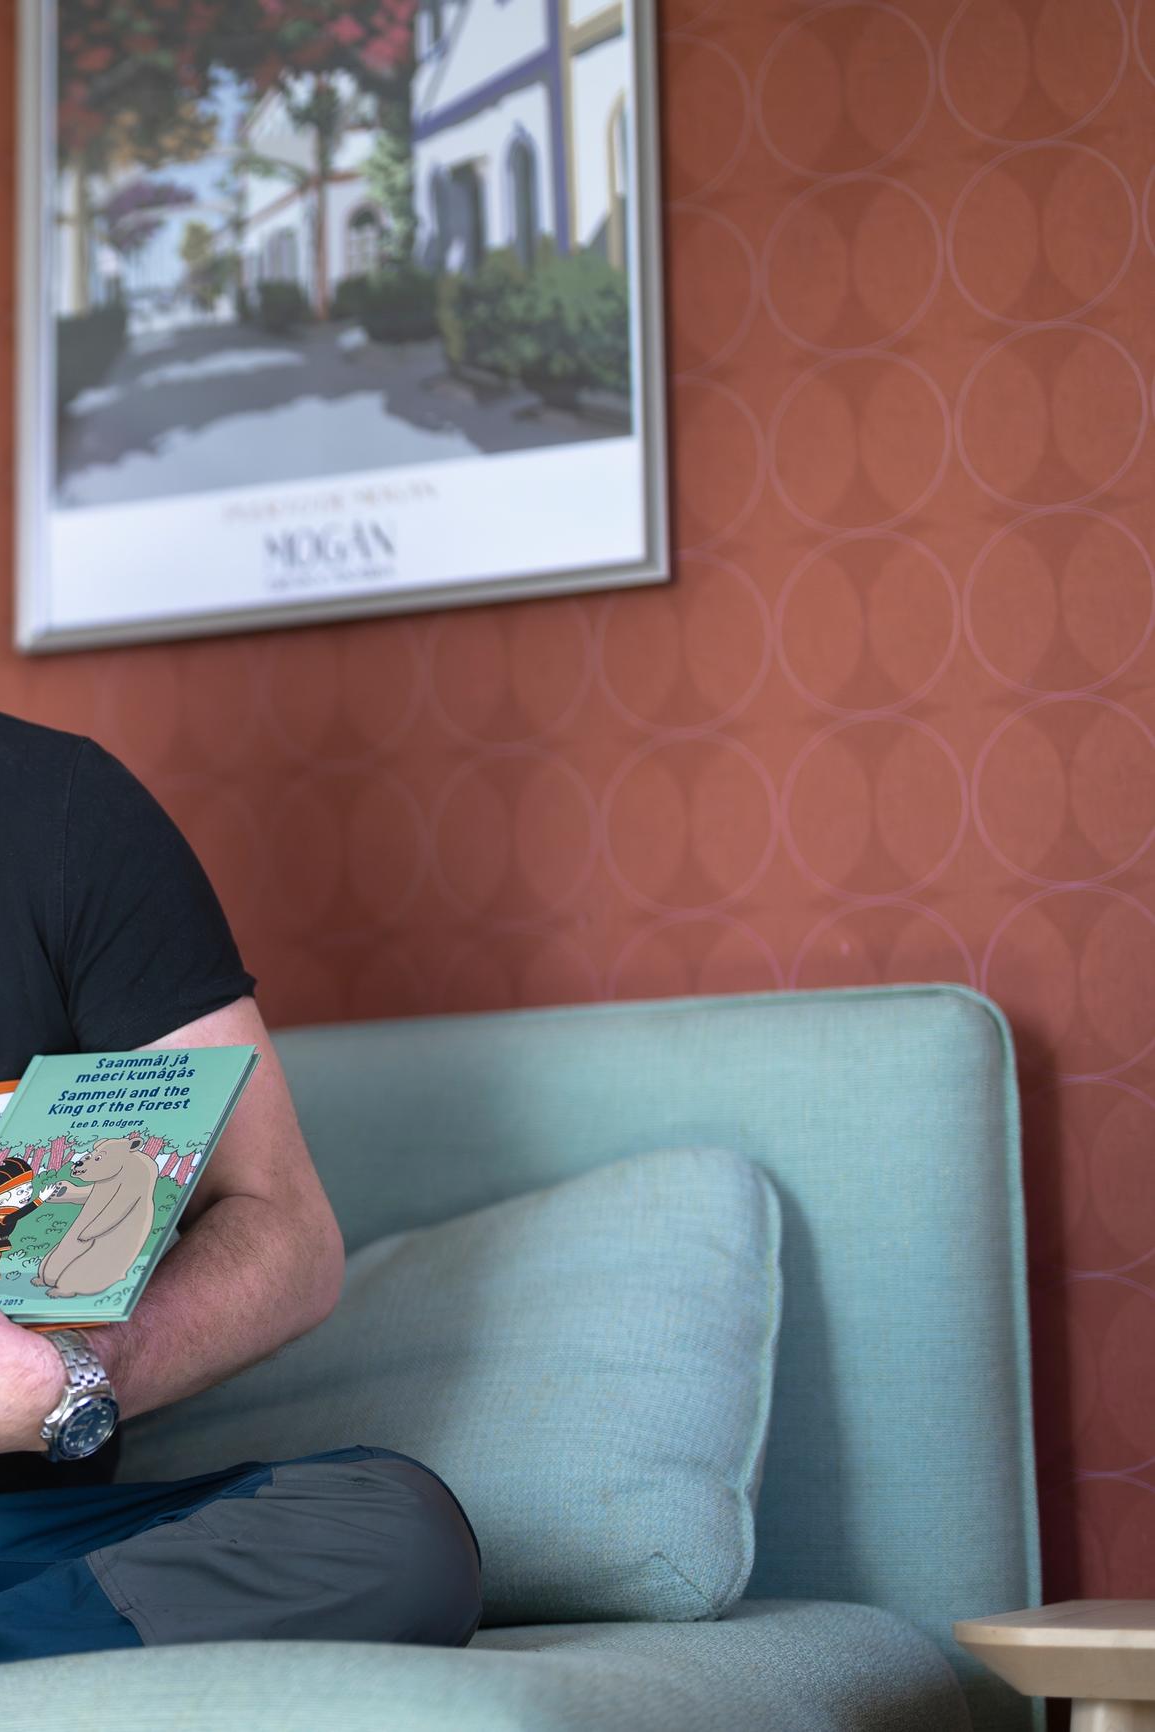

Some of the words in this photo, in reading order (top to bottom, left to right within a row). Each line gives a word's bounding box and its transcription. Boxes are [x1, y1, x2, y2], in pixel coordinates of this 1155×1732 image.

[96, 1054, 169, 1069] Saammâl
[169, 1053, 189, 1067] já
[75, 1071, 125, 1083] meeci
[126, 1067, 195, 1081] kunâgâs
[58, 1088, 128, 1101] Sammeli
[129, 1086, 161, 1098] and
[163, 1086, 190, 1097] the
[47, 1103, 84, 1117] King
[86, 1102, 107, 1113] of
[108, 1101, 135, 1112] the
[137, 1098, 191, 1111] Forest
[70, 1121, 89, 1129] Lee
[90, 1120, 100, 1128] D.
[102, 1119, 145, 1129] Rodgers
